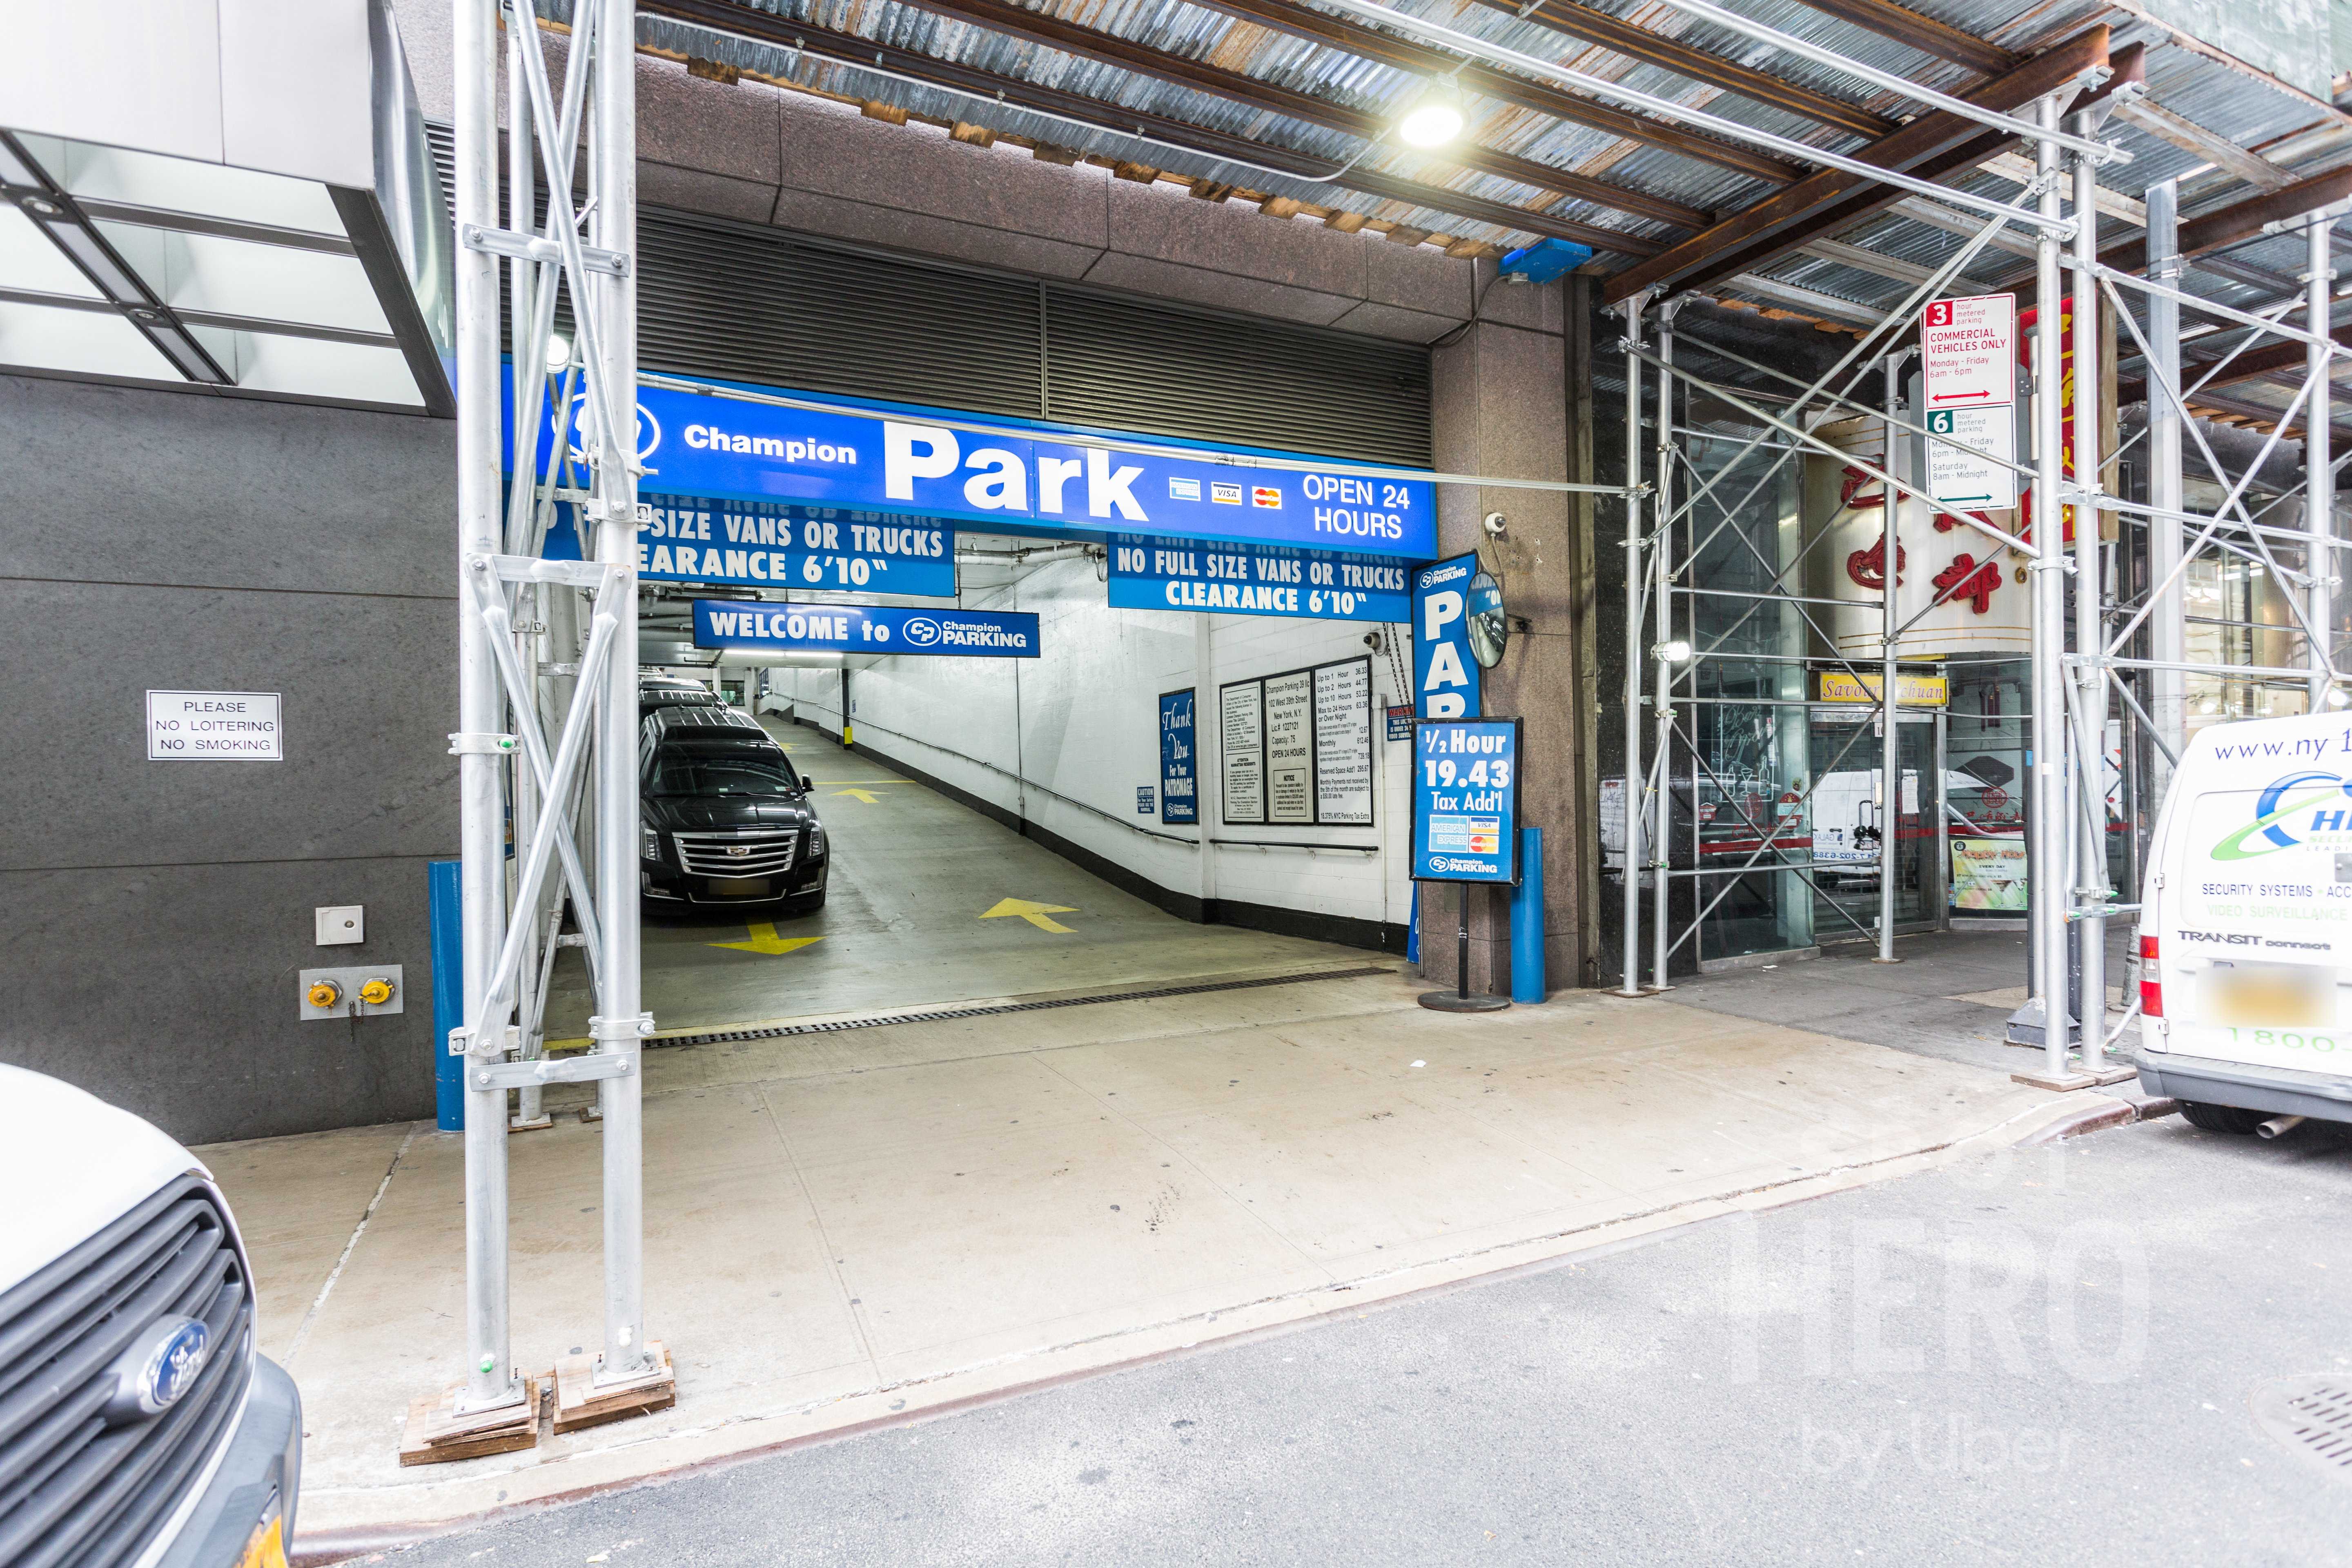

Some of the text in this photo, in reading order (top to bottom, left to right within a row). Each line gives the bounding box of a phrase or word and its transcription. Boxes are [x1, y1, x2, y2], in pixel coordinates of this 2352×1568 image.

[1933, 304, 1947, 325] 3
[1956, 309, 1985, 317] metered
[1956, 316, 1982, 325] parking
[1930, 328, 1996, 342] COMMERCIAL
[1931, 339, 2007, 354] VEHICLES ONLY
[1930, 356, 1989, 369] Monday Friday
[1930, 367, 1972, 378] 6am 6pm
[1933, 413, 1949, 433] 6
[1958, 425, 1982, 434] parking
[684, 423, 857, 465] Champion
[884, 421, 1149, 522] Park
[1933, 463, 1968, 471] Saturday
[1957, 470, 1988, 479] Midnight
[1217, 489, 1237, 497] VISA
[1303, 474, 1410, 510] OPEN 24
[1314, 507, 1402, 539] HOURS
[651, 508, 943, 557] SIZE VANS OR TRUCKS
[638, 545, 786, 580] EARANCE
[1118, 547, 1404, 590] NO FULL SIZE VANS OR TRUCKS
[1433, 566, 1457, 576] Champion
[1433, 567, 1467, 584] PARKING
[1166, 581, 1298, 612] CLEARANCE
[709, 612, 890, 643] WELCOME to
[942, 621, 1001, 633] Champion
[942, 629, 1027, 648] PARKING
[1355, 667, 1367, 675] 36.33
[1266, 680, 1304, 695] Champion Parking 39
[1356, 689, 1368, 697] 53.22
[1900, 682, 1943, 699] chuan
[1276, 698, 1285, 706] West
[1286, 696, 1294, 705] 39th
[1295, 695, 1307, 704] Street
[1356, 701, 1368, 709] 63.36
[184, 702, 246, 712] PLEASE
[1163, 699, 1192, 730] Thank
[1283, 710, 1293, 719] York,
[1294, 709, 1302, 717] N.Y.
[1335, 713, 1347, 722] Night
[156, 720, 274, 731] NO LOITERING
[1283, 722, 1299, 731] 1227121
[161, 739, 270, 750] NO SMOKING
[1168, 733, 1190, 759] You
[1272, 735, 1296, 746] Capacity: 75
[1450, 728, 1506, 754] Hour
[1272, 748, 1306, 758] OPEN 24 HOURS
[1177, 764, 1187, 776] Your
[1336, 767, 1346, 775] Space
[1425, 759, 1510, 788] 19.43
[1165, 777, 1193, 796] PATRONAGE
[1431, 791, 1503, 812] Tax Add'l
[1341, 813, 1354, 821] Parking
[1431, 824, 1465, 833] AMERICAN
[1438, 835, 1467, 844] EXPRESS
[1961, 850, 1997, 860] Happy
[1450, 864, 1498, 873] PARKING
[2202, 883, 2253, 896] SECURITY
[2260, 884, 2313, 897] SYSTEMS
[2207, 904, 2348, 921] VIDEO SURVEILLANCE
[2178, 930, 2331, 950] TRANSIT connect
[169, 1334, 206, 1393] Ford
